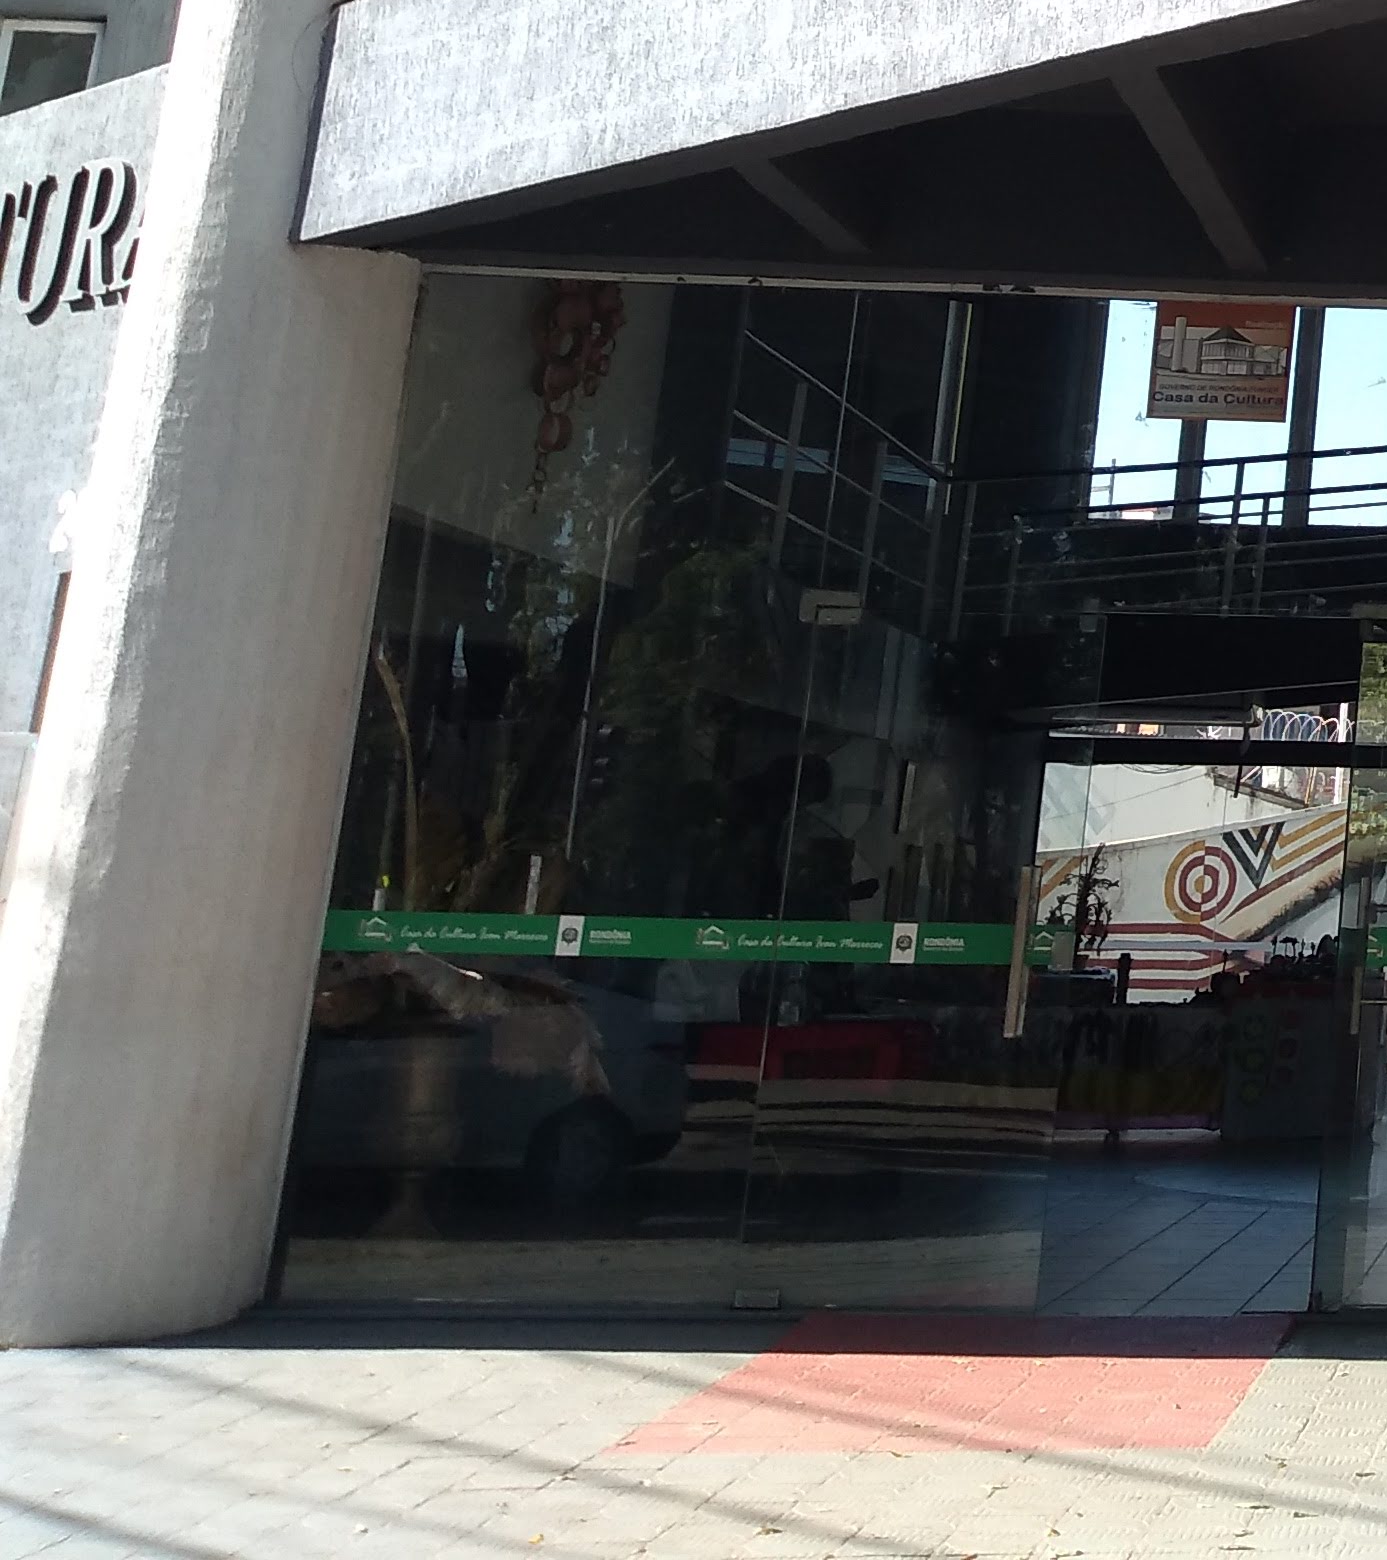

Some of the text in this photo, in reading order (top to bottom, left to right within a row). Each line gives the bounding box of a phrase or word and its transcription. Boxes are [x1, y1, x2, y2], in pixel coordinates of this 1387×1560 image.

[1152, 391, 1284, 405] Casa da Cultura
